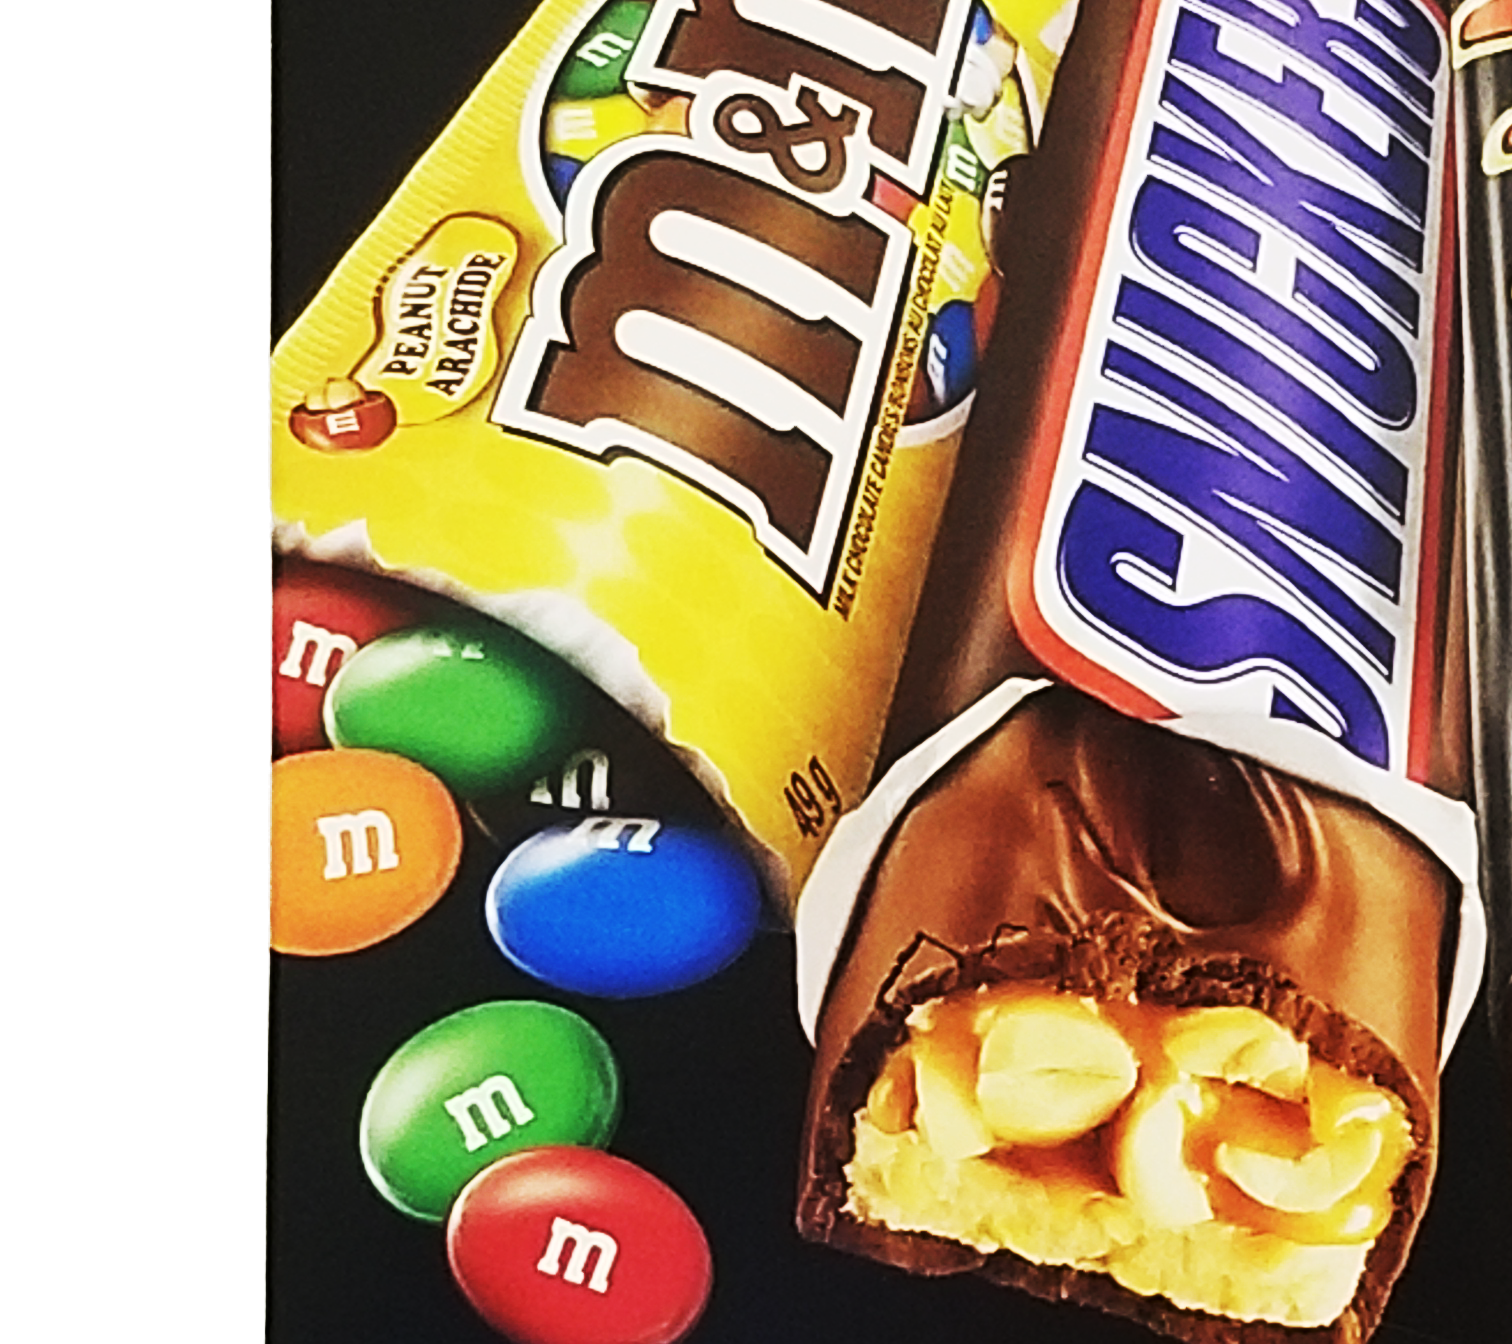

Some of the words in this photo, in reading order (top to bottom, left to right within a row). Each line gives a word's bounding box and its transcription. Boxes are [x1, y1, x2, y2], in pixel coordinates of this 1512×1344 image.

[380, 266, 449, 376] PEANUT
[425, 253, 508, 396] ARACHIDE
[783, 771, 824, 838] 49
[809, 755, 842, 815] g
